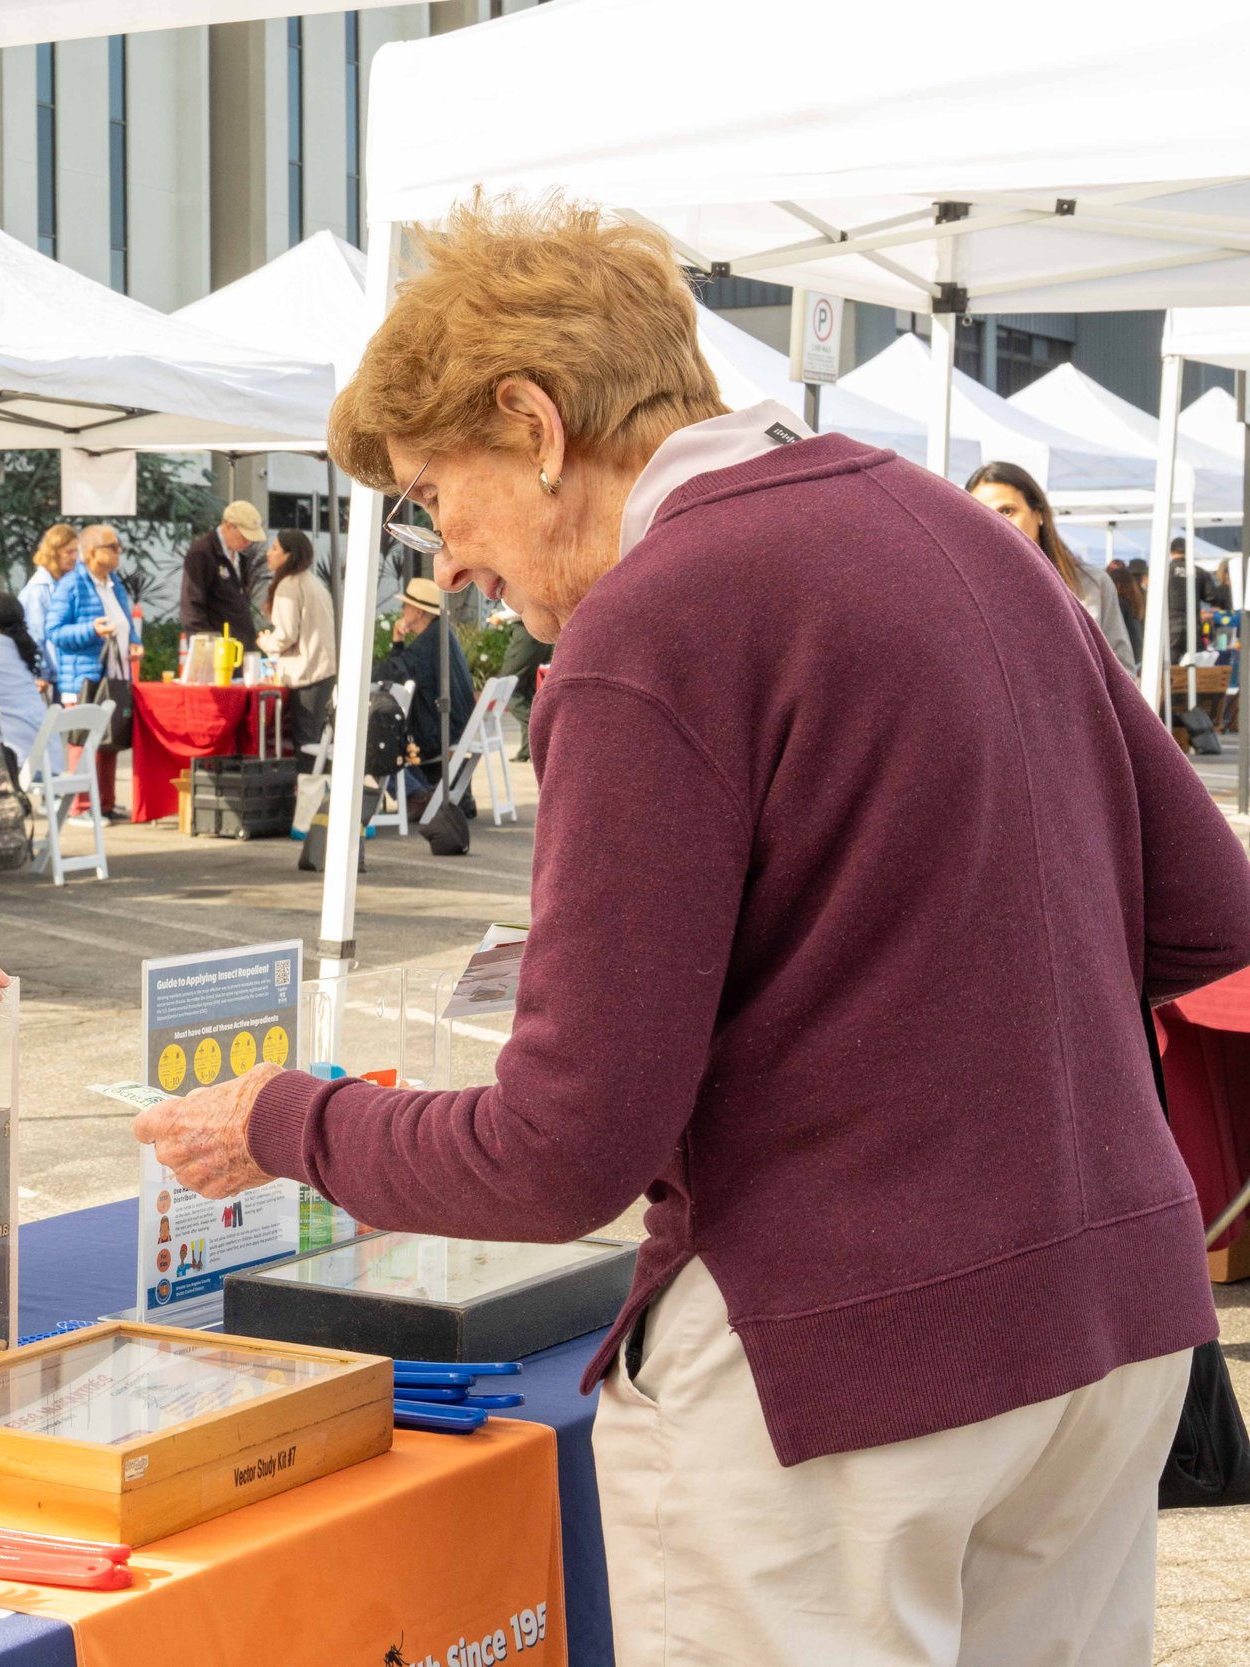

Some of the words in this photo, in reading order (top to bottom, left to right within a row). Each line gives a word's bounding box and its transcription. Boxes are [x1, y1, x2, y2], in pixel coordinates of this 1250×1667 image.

[818, 308, 827, 332] P
[157, 978, 177, 989] Guide
[186, 972, 217, 986] Applying
[218, 969, 237, 980] Insect
[238, 964, 269, 978] Repellent
[174, 1030, 187, 1039] Must
[188, 1027, 201, 1037] have
[202, 1026, 212, 1034] ONE
[219, 1023, 233, 1031] these
[234, 1020, 249, 1029] Active
[250, 1015, 278, 1026] Ingredients
[234, 1465, 255, 1487] Vector
[257, 1458, 276, 1479] Study
[278, 1450, 287, 1471] Kit
[288, 1446, 297, 1468] #7
